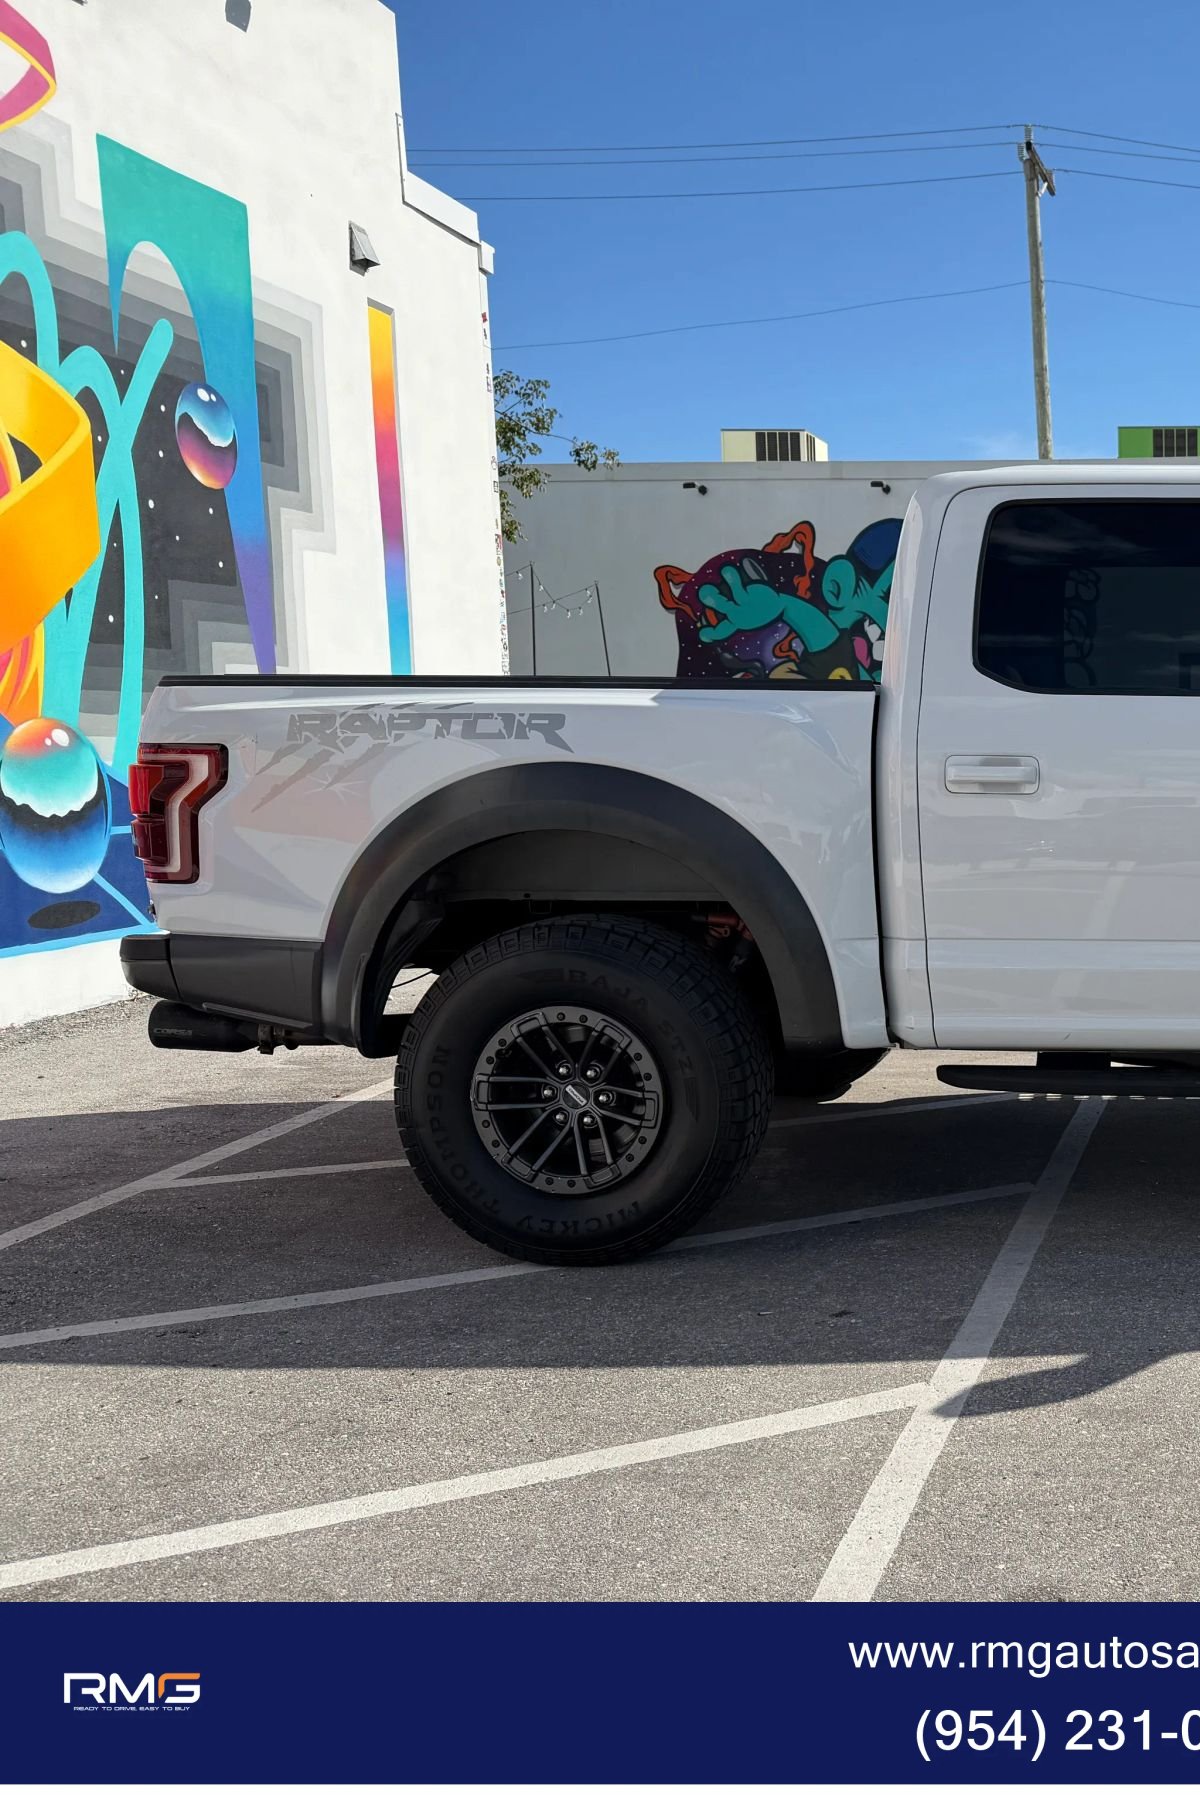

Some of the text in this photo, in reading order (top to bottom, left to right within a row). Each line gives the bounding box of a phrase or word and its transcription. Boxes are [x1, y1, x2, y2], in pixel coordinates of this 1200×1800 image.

[285, 711, 575, 753] RAPTOR
[427, 1045, 641, 1234] MICKEY THOMPSON
